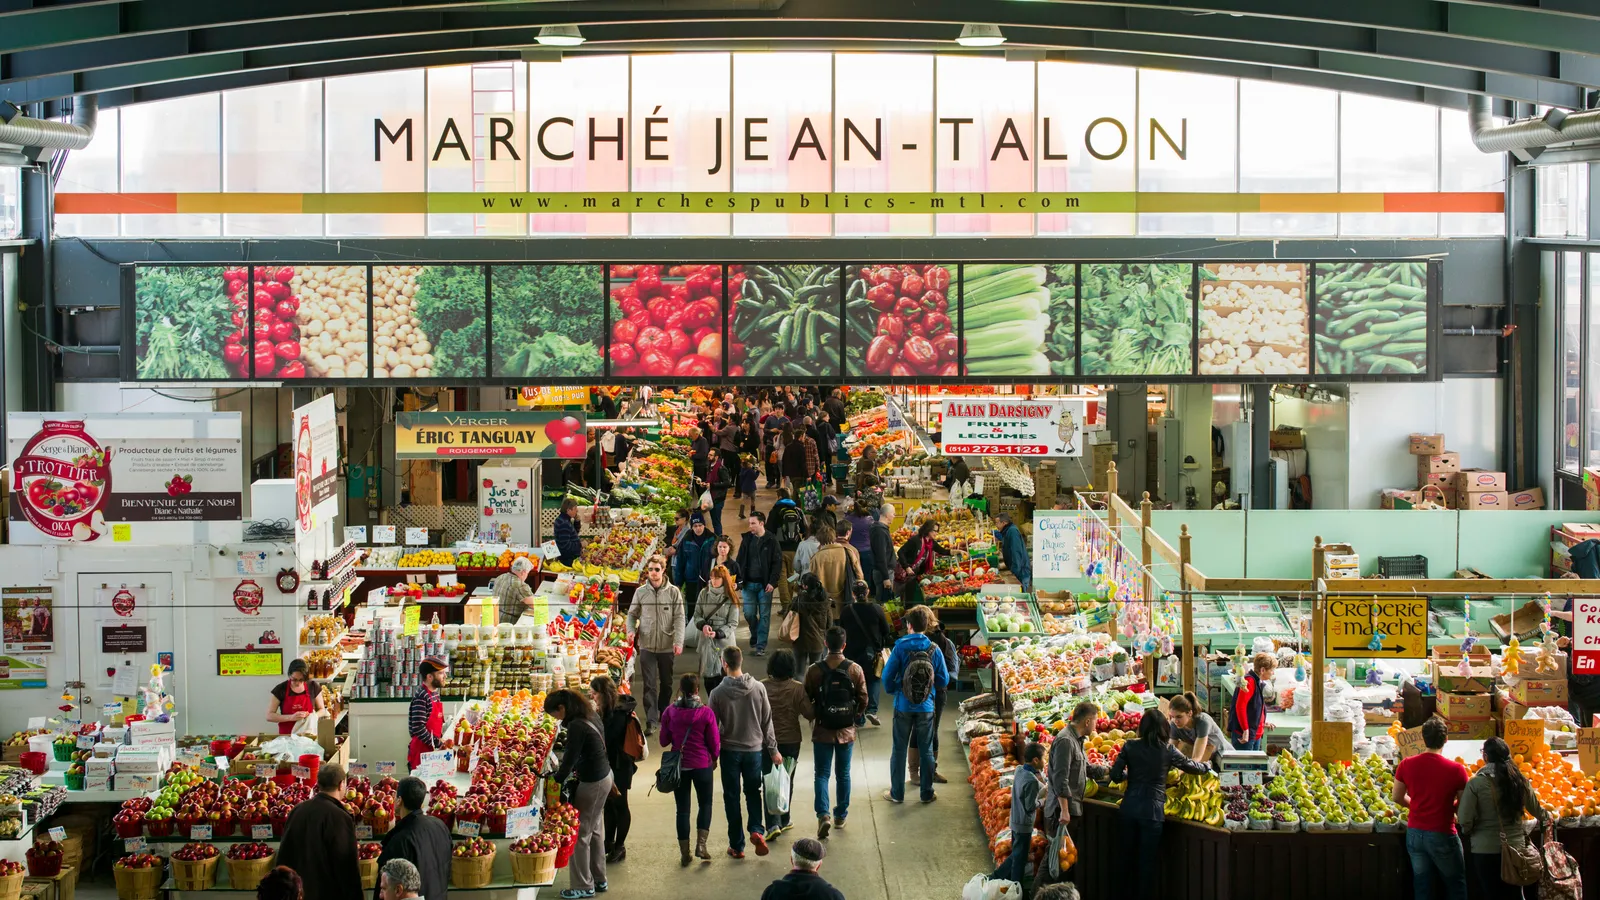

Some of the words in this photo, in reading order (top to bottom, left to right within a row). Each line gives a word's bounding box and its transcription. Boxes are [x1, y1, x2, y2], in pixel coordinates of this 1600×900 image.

[373, 105, 669, 162] MARCHÉ
[482, 193, 1081, 211] www.marchespublics-mtl.com
[524, 387, 538, 398] JUS
[542, 386, 552, 395] DE
[946, 402, 986, 417] ALAIN
[988, 402, 1053, 419] DARSIGNY
[444, 416, 508, 426] VERGER
[416, 428, 454, 444] ÉRIC
[460, 430, 536, 444] TANGUAY
[40, 445, 60, 454] Serge
[68, 445, 89, 454] Diane
[206, 447, 238, 455] légumes
[25, 460, 100, 481] TROTTIER
[122, 498, 178, 507] BIENVENUE
[488, 498, 518, 508] POMME
[52, 522, 70, 531] OKA
[1040, 518, 1076, 530] Chocolats
[1580, 604, 1600, 612] Co
[1331, 621, 1342, 635] du
[1576, 656, 1596, 669] En
[1527, 682, 1542, 690] Dole
[1450, 696, 1466, 704] Dole
